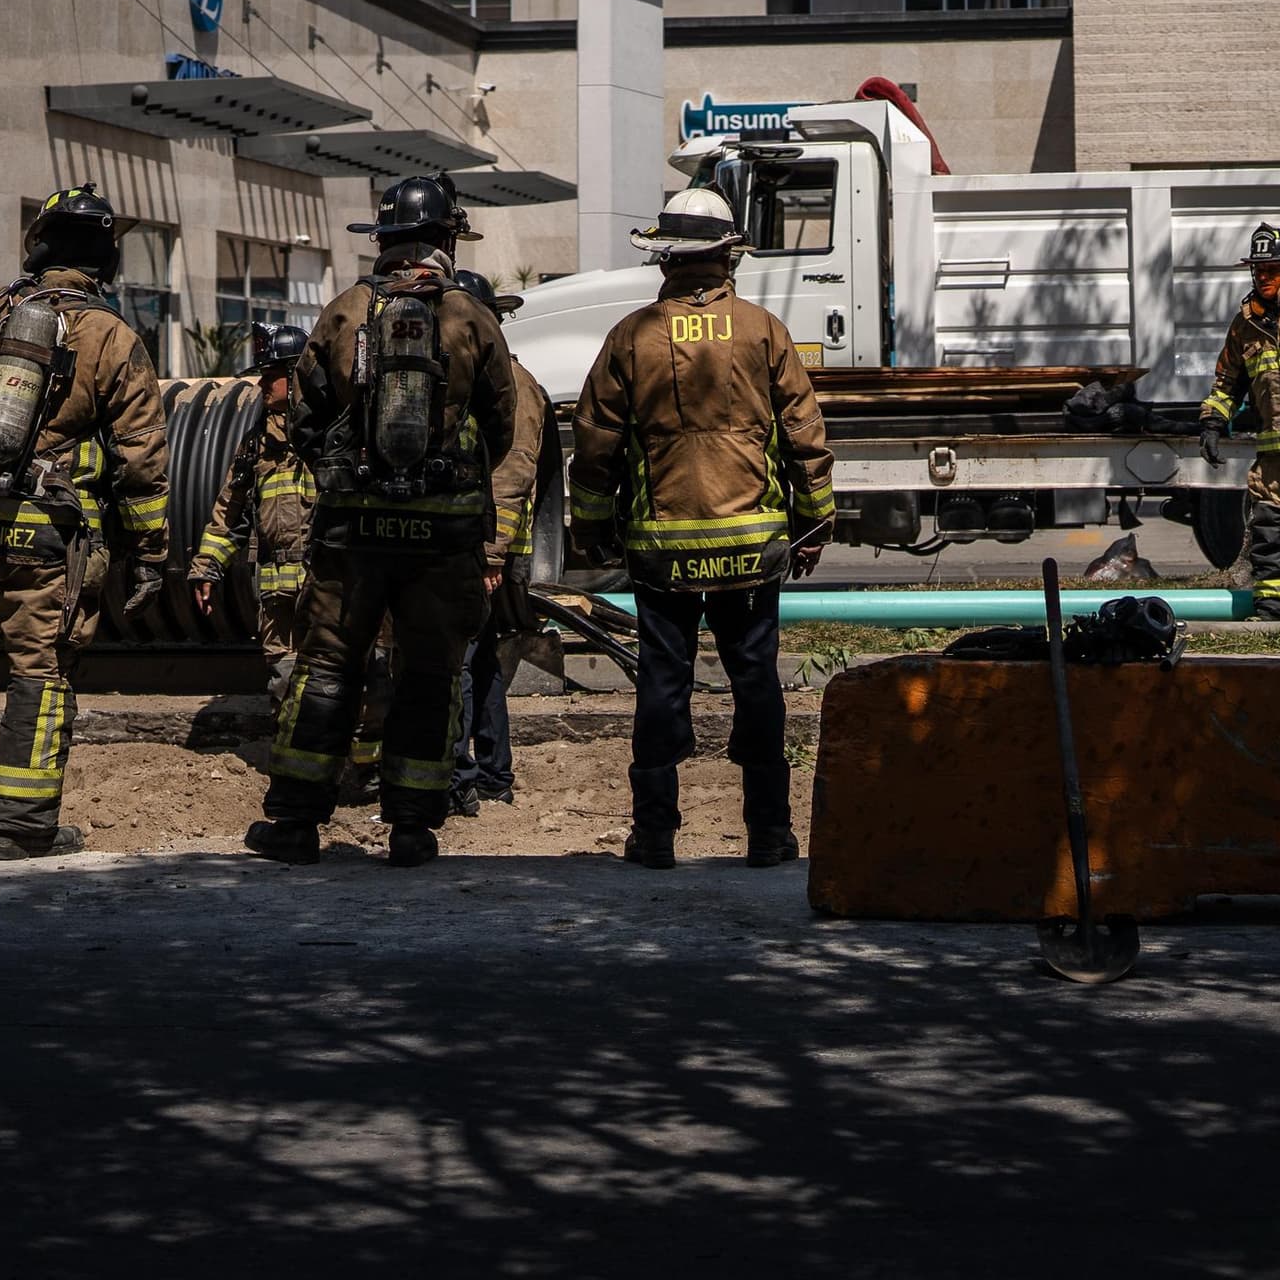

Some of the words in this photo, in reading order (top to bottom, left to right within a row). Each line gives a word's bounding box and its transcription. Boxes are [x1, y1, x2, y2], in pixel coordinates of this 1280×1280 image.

[392, 320, 424, 340] 25
[671, 313, 733, 342] DBTJ
[21, 379, 40, 392] SCOT
[376, 518, 432, 539] REYES
[671, 560, 683, 581] A
[687, 553, 762, 579] SANCHEZ
